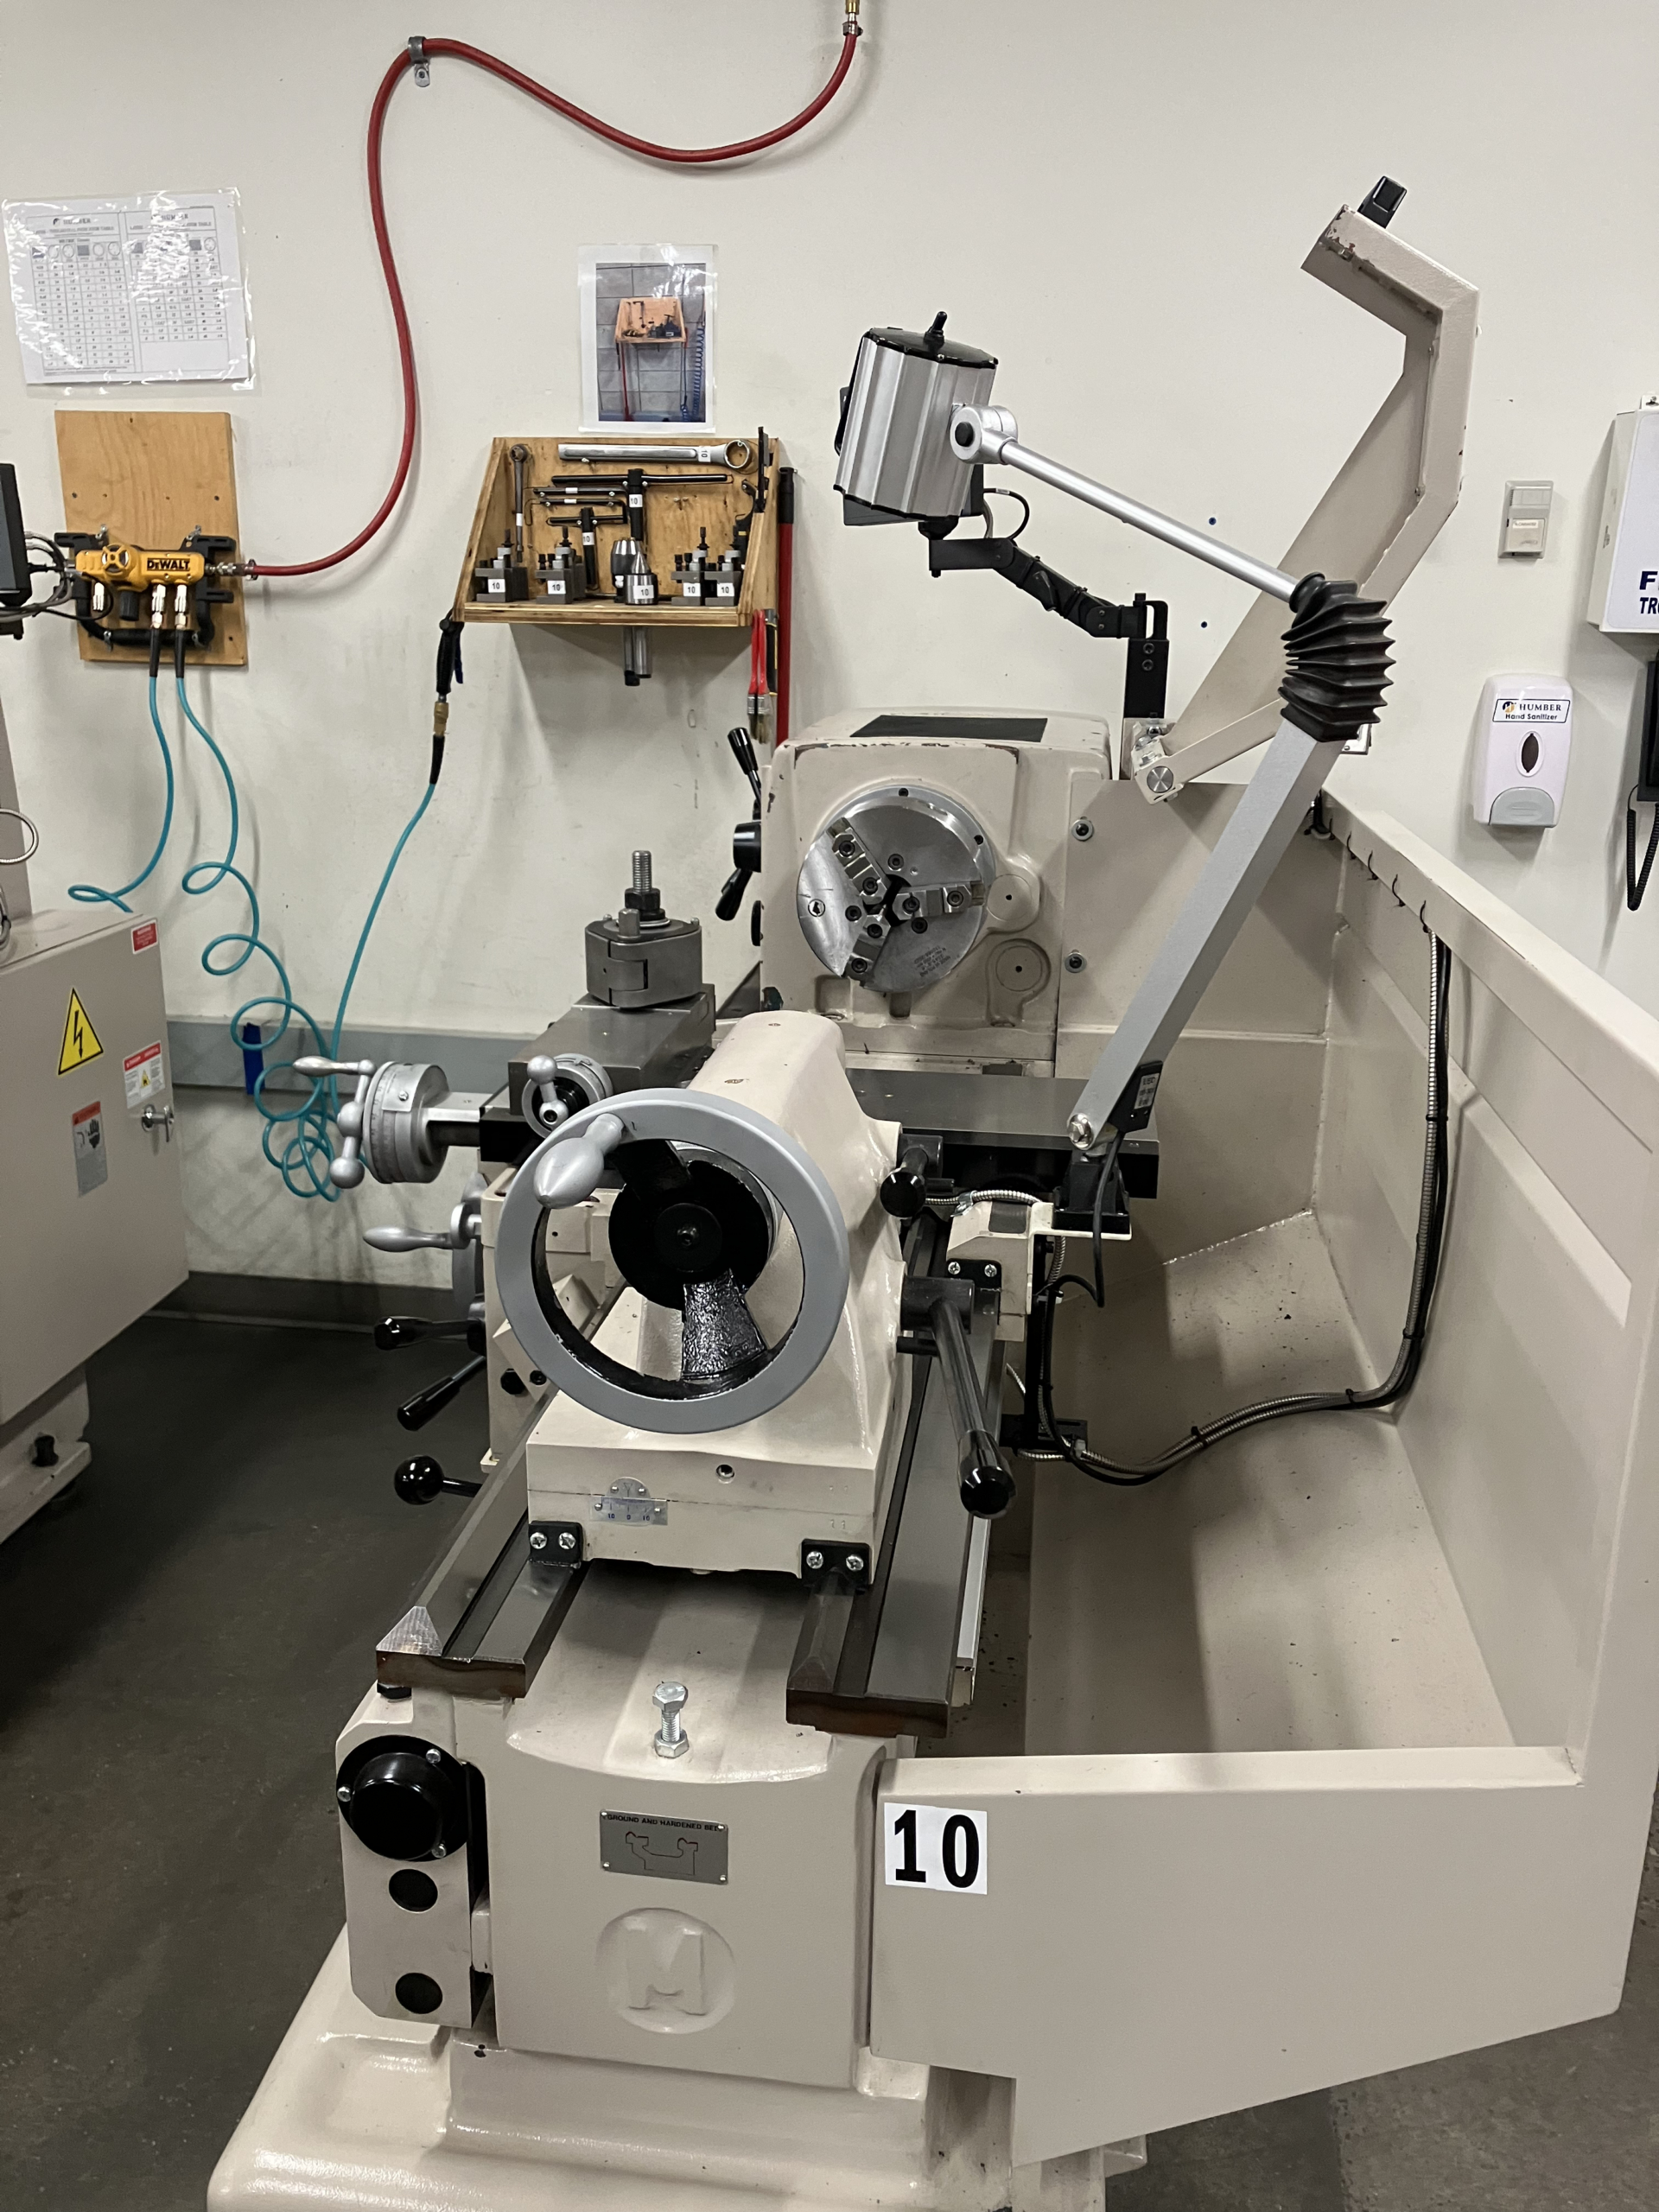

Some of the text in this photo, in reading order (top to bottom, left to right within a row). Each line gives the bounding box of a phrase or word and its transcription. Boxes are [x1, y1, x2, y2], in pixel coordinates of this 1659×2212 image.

[147, 558, 190, 570] DEWALT
[1639, 596, 1659, 614] TR
[607, 1814, 639, 1823] GROUND
[659, 1820, 702, 1830] HARDENED
[894, 1809, 980, 1889] 10
